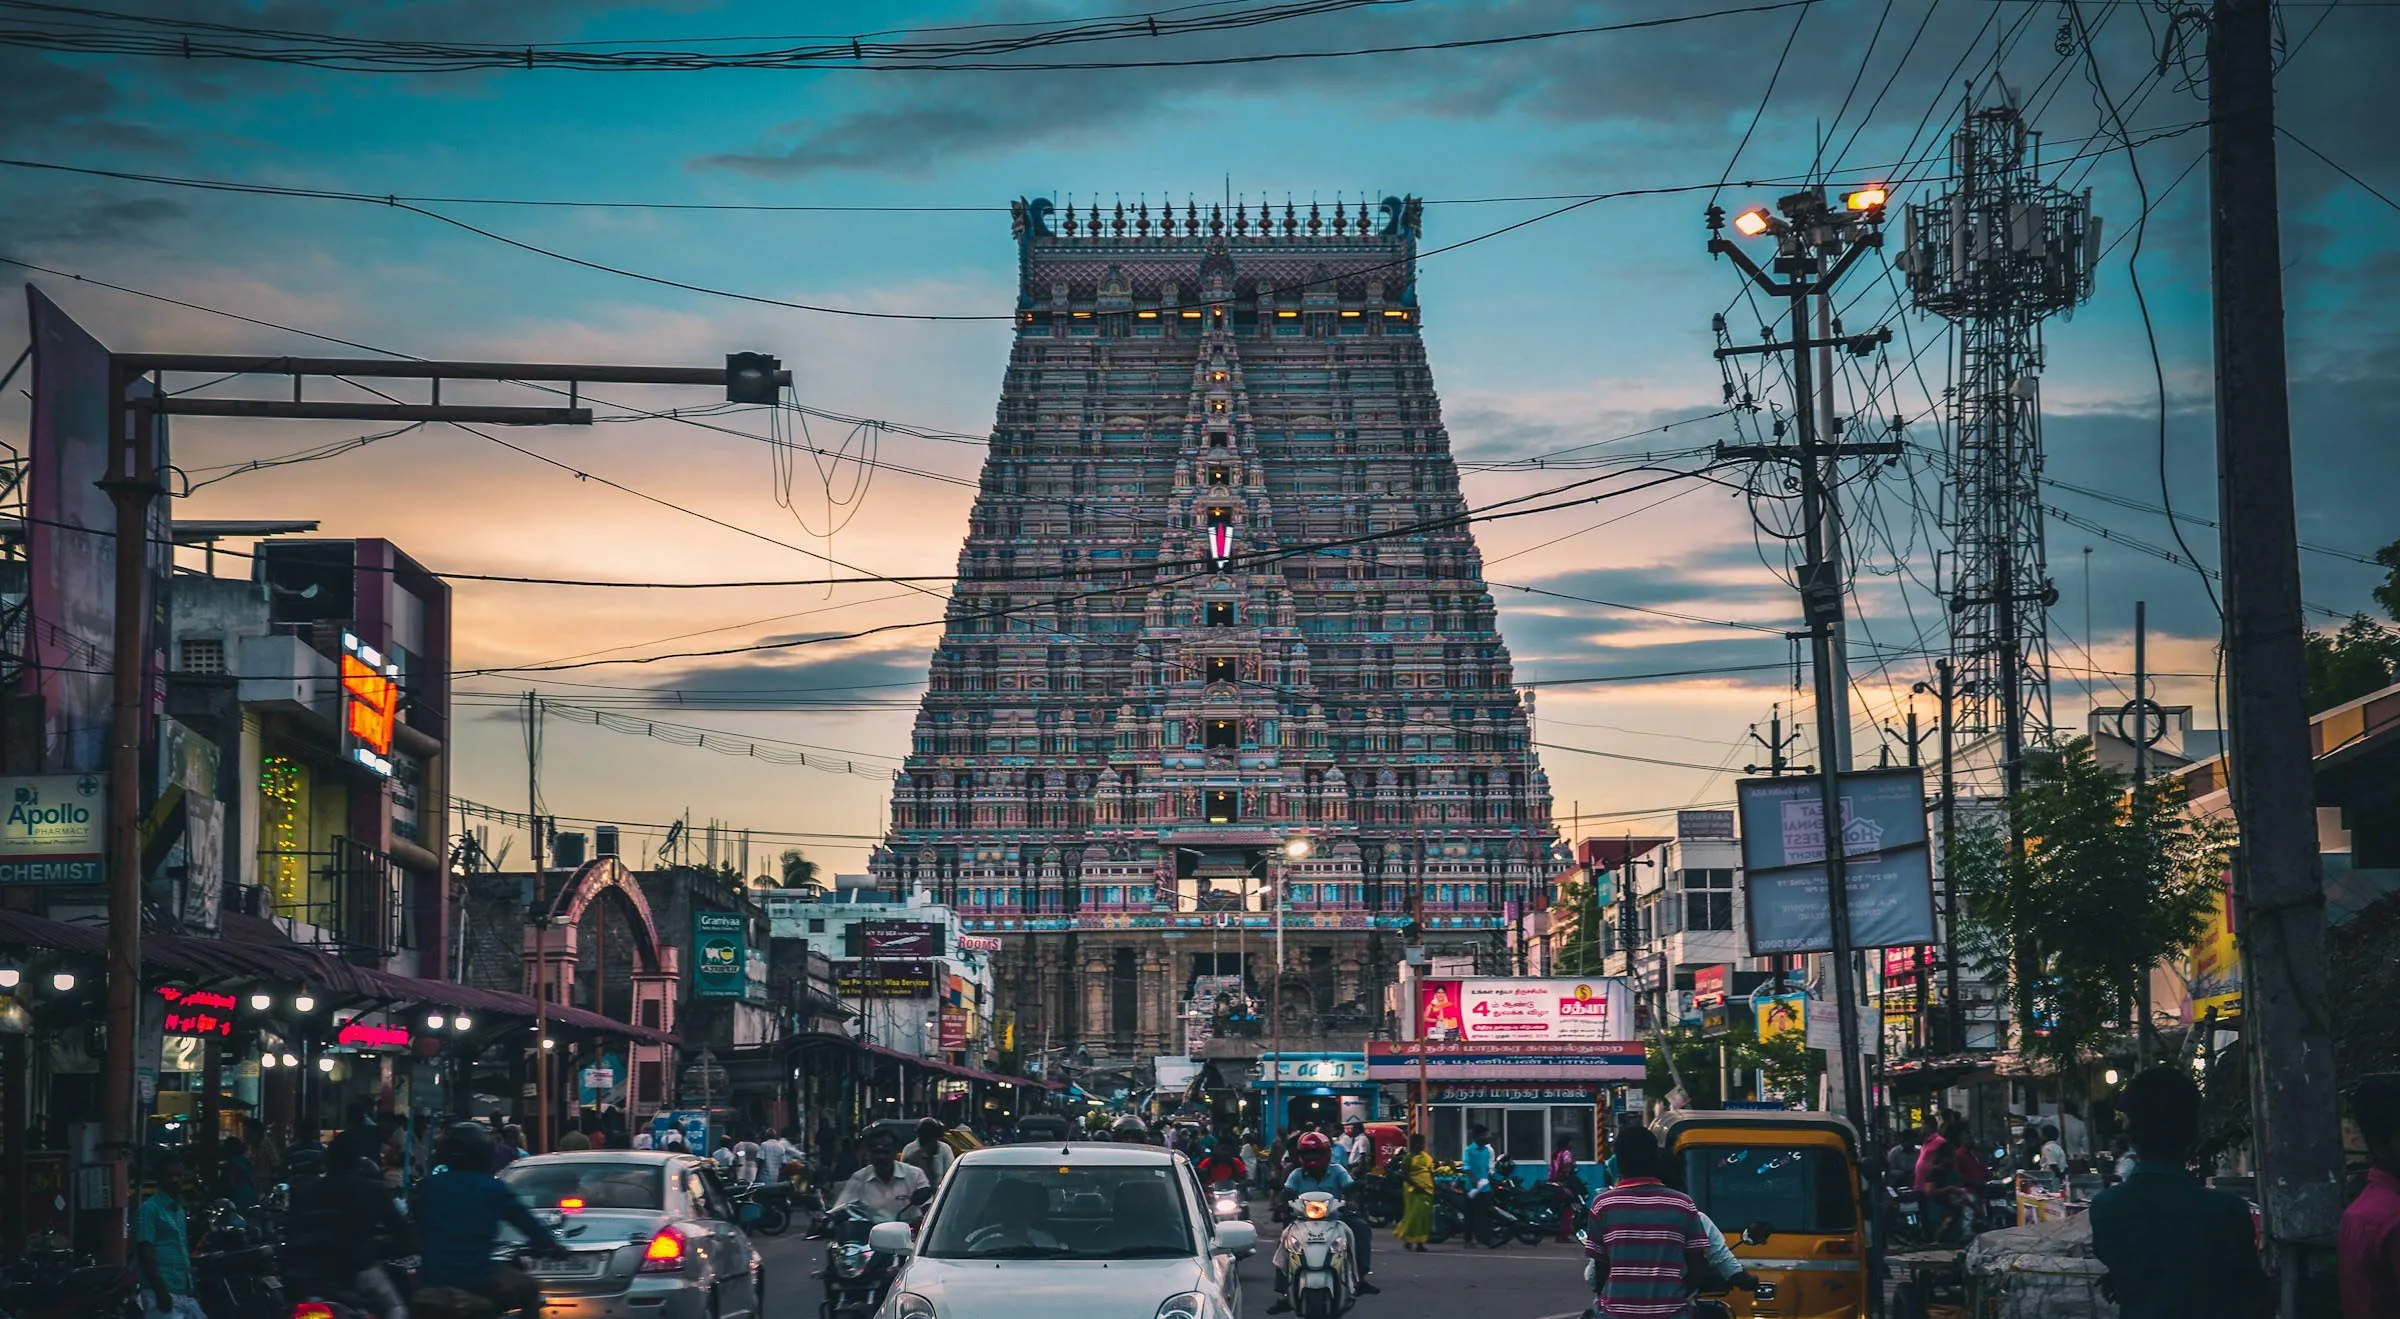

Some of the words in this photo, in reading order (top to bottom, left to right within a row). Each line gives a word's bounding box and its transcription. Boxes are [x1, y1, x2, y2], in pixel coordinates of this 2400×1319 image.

[7, 803, 90, 836] Apollo
[34, 827, 90, 836] PHARMACY
[0, 862, 96, 881] CHEMIST
[958, 936, 1000, 950] ROOMS
[1472, 1001, 1491, 1017] 4
